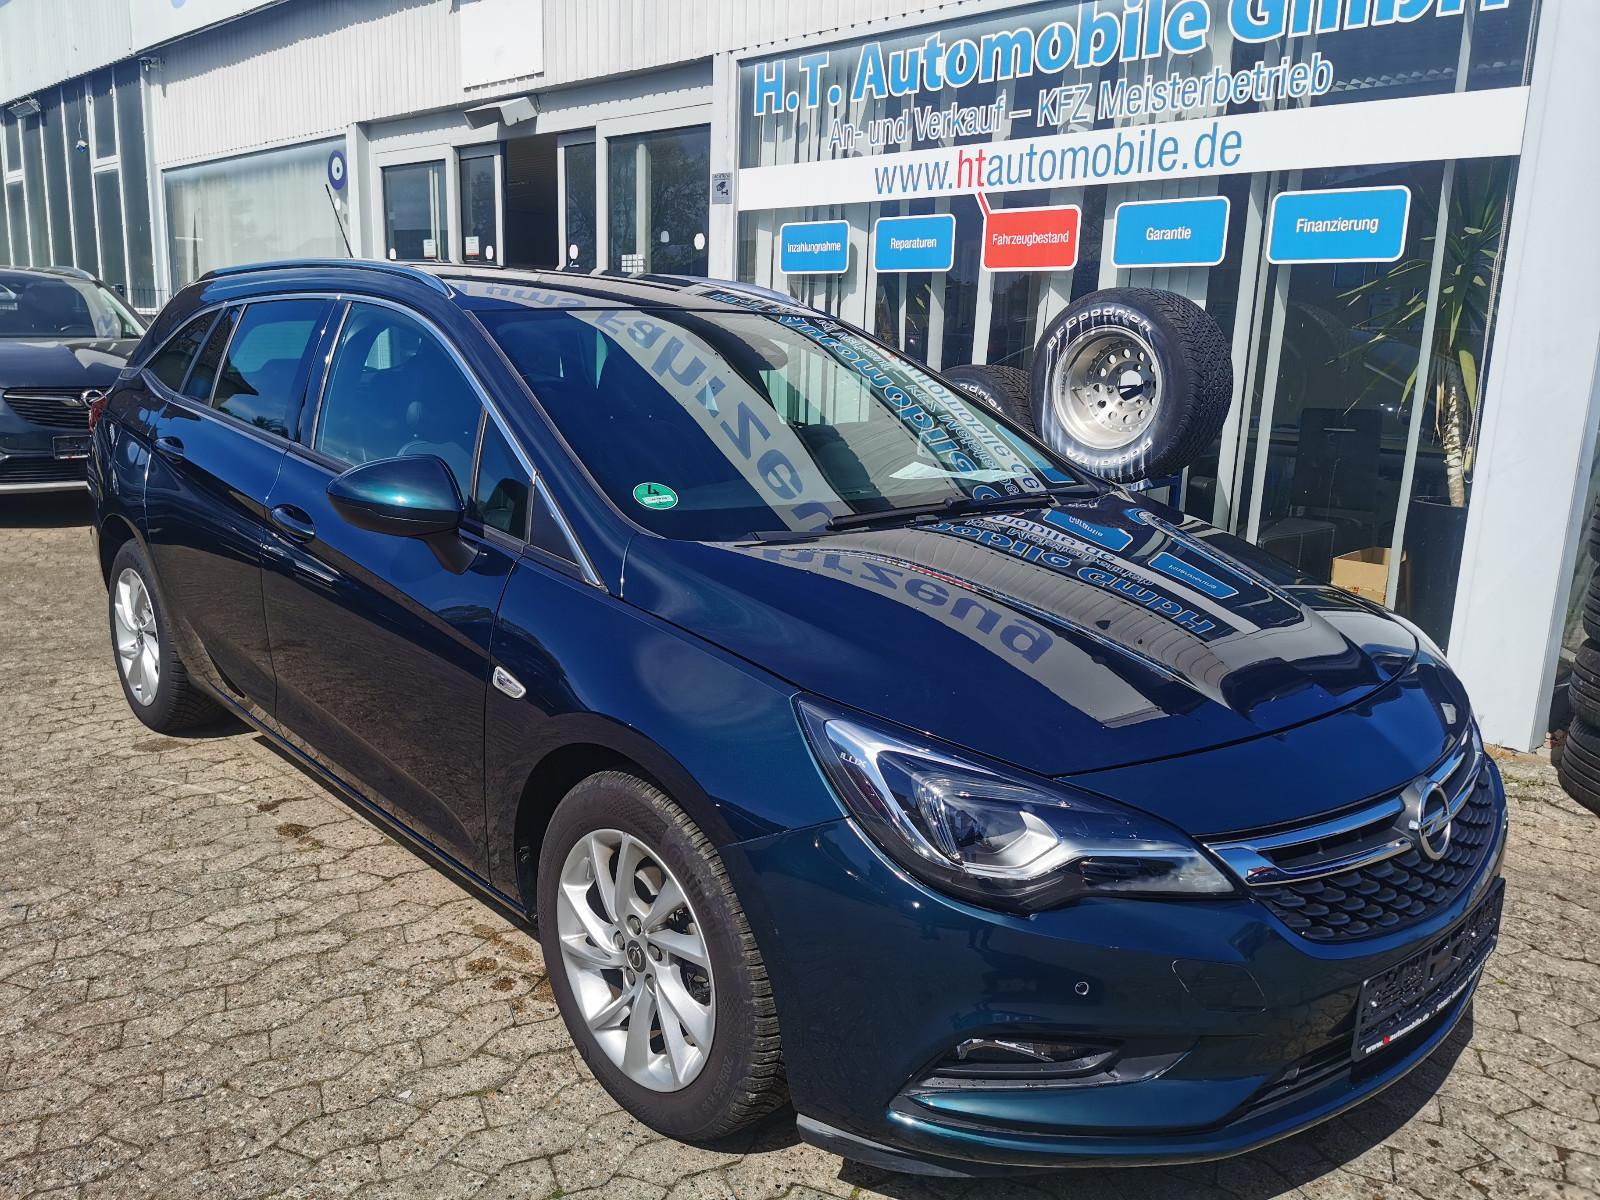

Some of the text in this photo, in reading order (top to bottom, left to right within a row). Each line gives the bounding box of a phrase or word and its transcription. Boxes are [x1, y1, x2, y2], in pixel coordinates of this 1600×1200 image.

[754, 0, 1510, 116] H.T. Automobile Gm
[828, 118, 864, 151] An-
[868, 108, 909, 145] und
[914, 88, 1006, 141] Verkauf
[1037, 82, 1093, 128] KFZ
[1097, 52, 1335, 120] Meisterbetrieb
[874, 122, 1243, 195] www.htautomobile.de
[1145, 225, 1192, 241] Garantie
[1295, 217, 1379, 235] Finanzierung
[786, 239, 842, 253] Inzahlungnahme
[889, 236, 937, 250] Reparaturen
[992, 230, 1070, 246] Fahrzeugbestand
[1047, 306, 1153, 350] BFGoodrich
